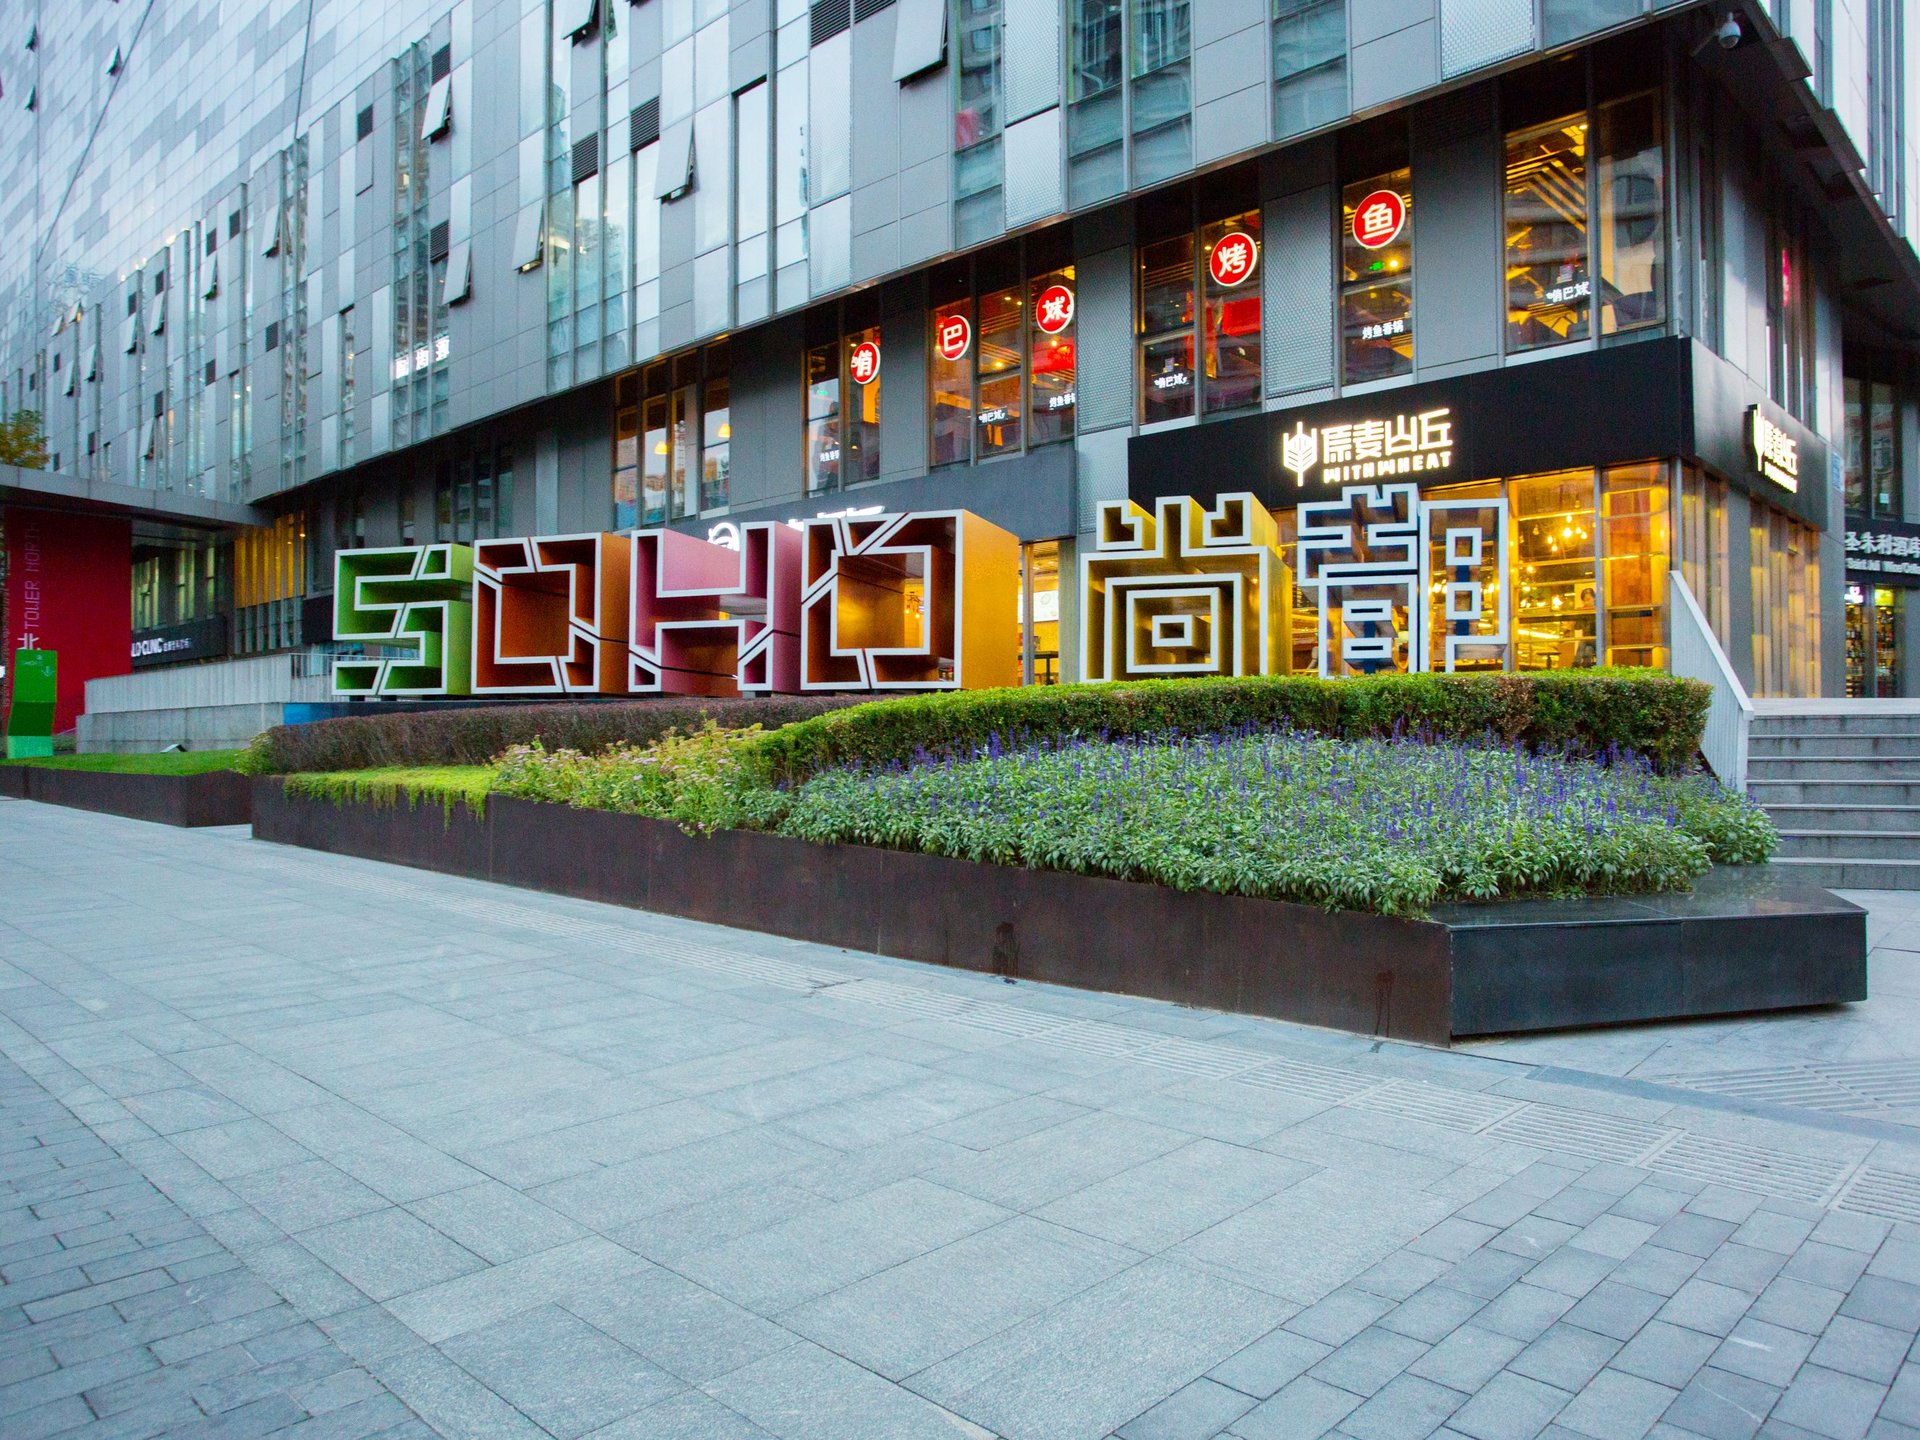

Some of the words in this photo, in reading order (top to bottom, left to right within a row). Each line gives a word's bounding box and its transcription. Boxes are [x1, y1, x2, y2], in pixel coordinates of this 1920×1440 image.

[943, 324, 963, 352] 巴
[1218, 243, 1247, 278] 烤
[1362, 203, 1395, 239] 鱼
[1321, 408, 1453, 464] 原麦山丘
[24, 579, 41, 629] TOWER
[333, 509, 963, 695] SOHO
